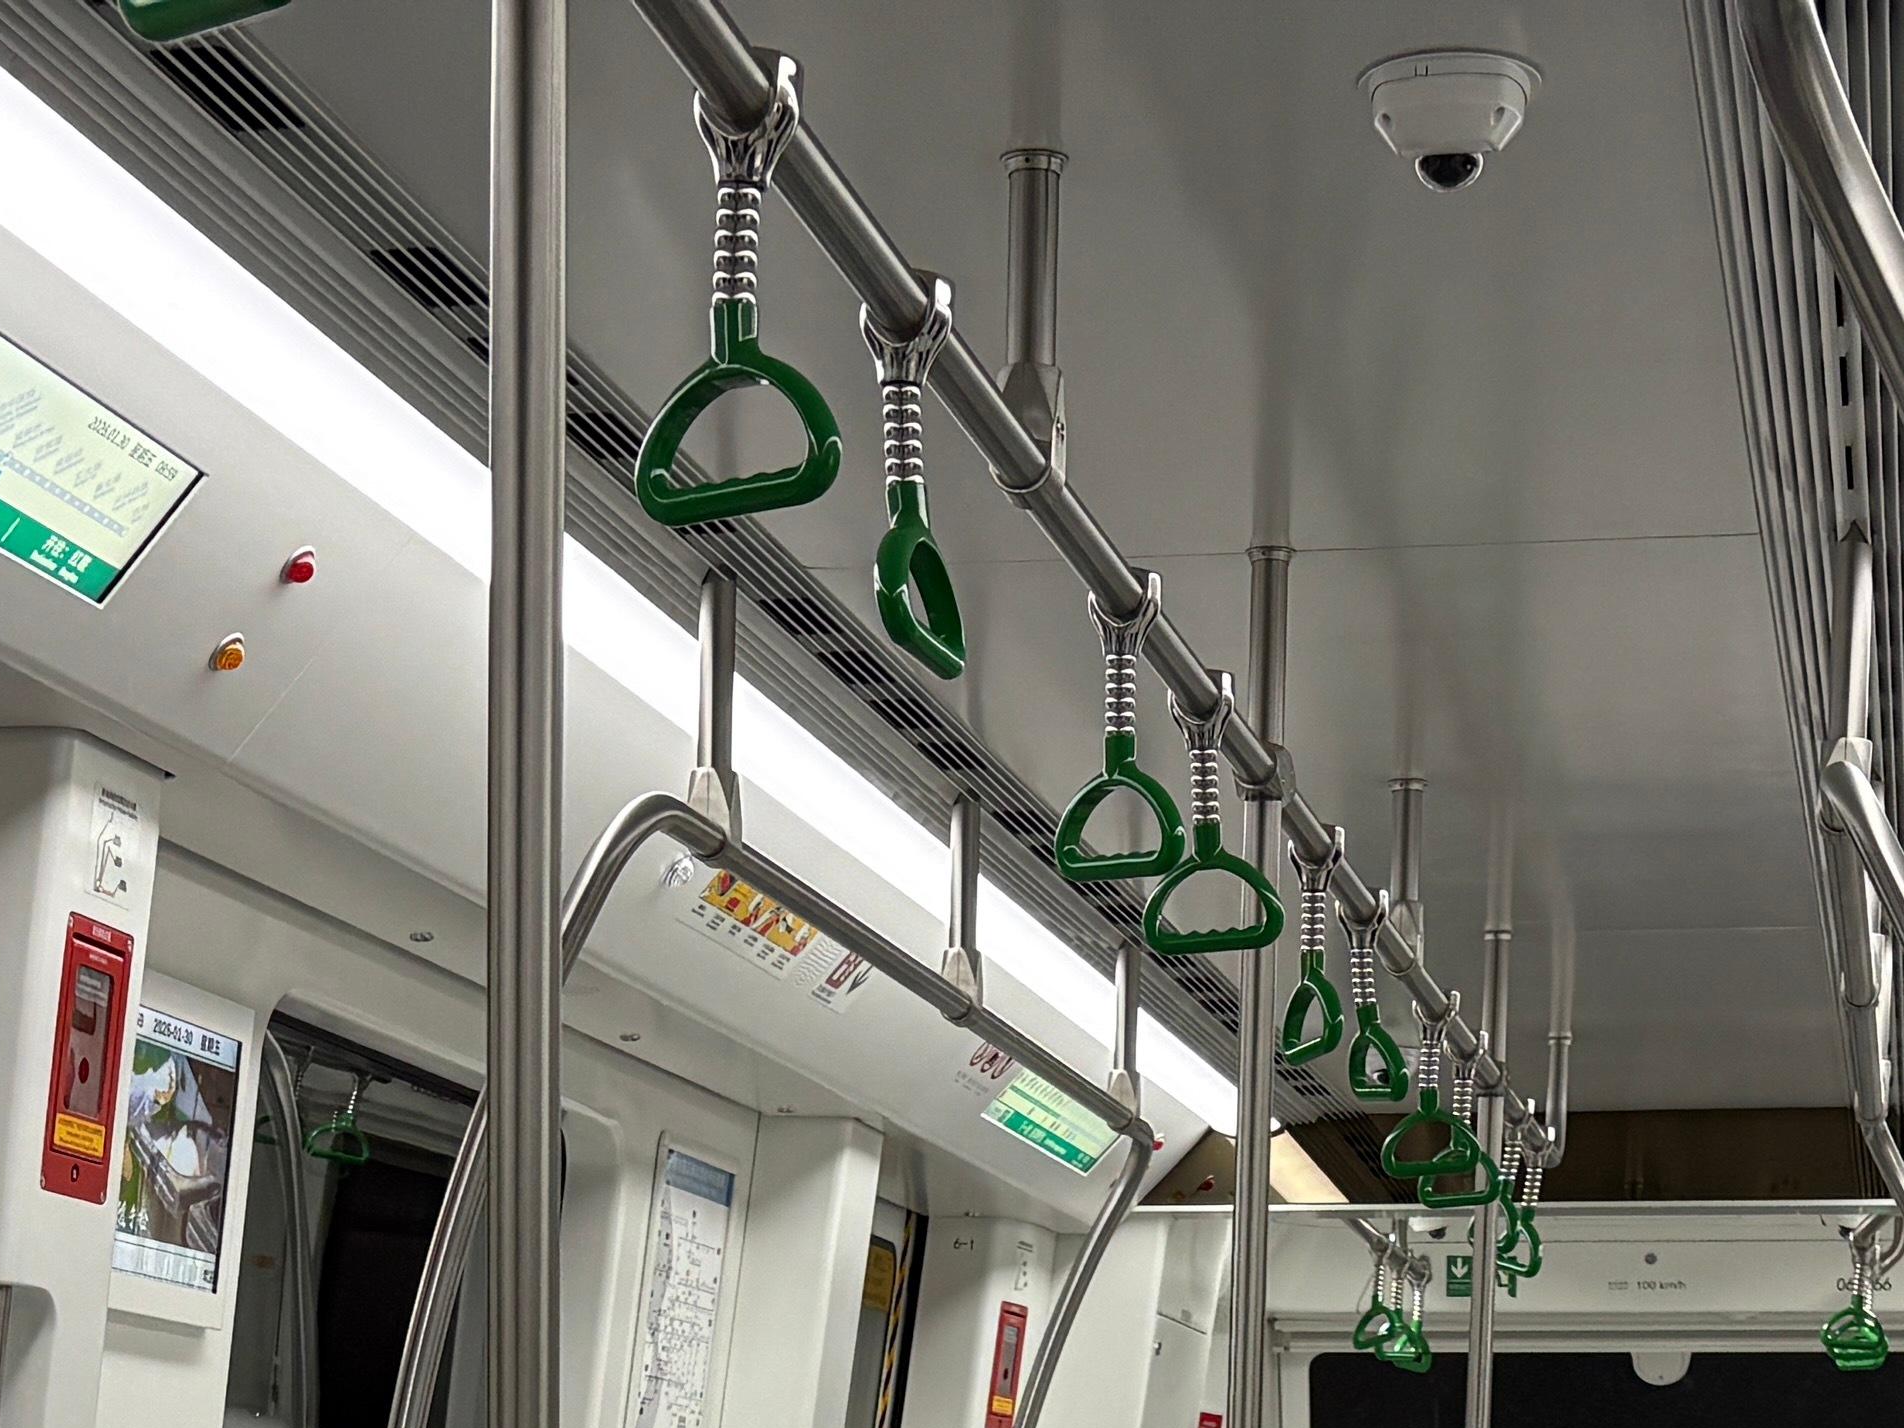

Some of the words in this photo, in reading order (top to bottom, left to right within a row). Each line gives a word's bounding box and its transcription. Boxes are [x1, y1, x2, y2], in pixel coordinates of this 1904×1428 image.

[152, 1016, 194, 1046] 2026-01-30
[953, 1237, 975, 1251] 6-1
[1637, 1280, 1657, 1291] 100
